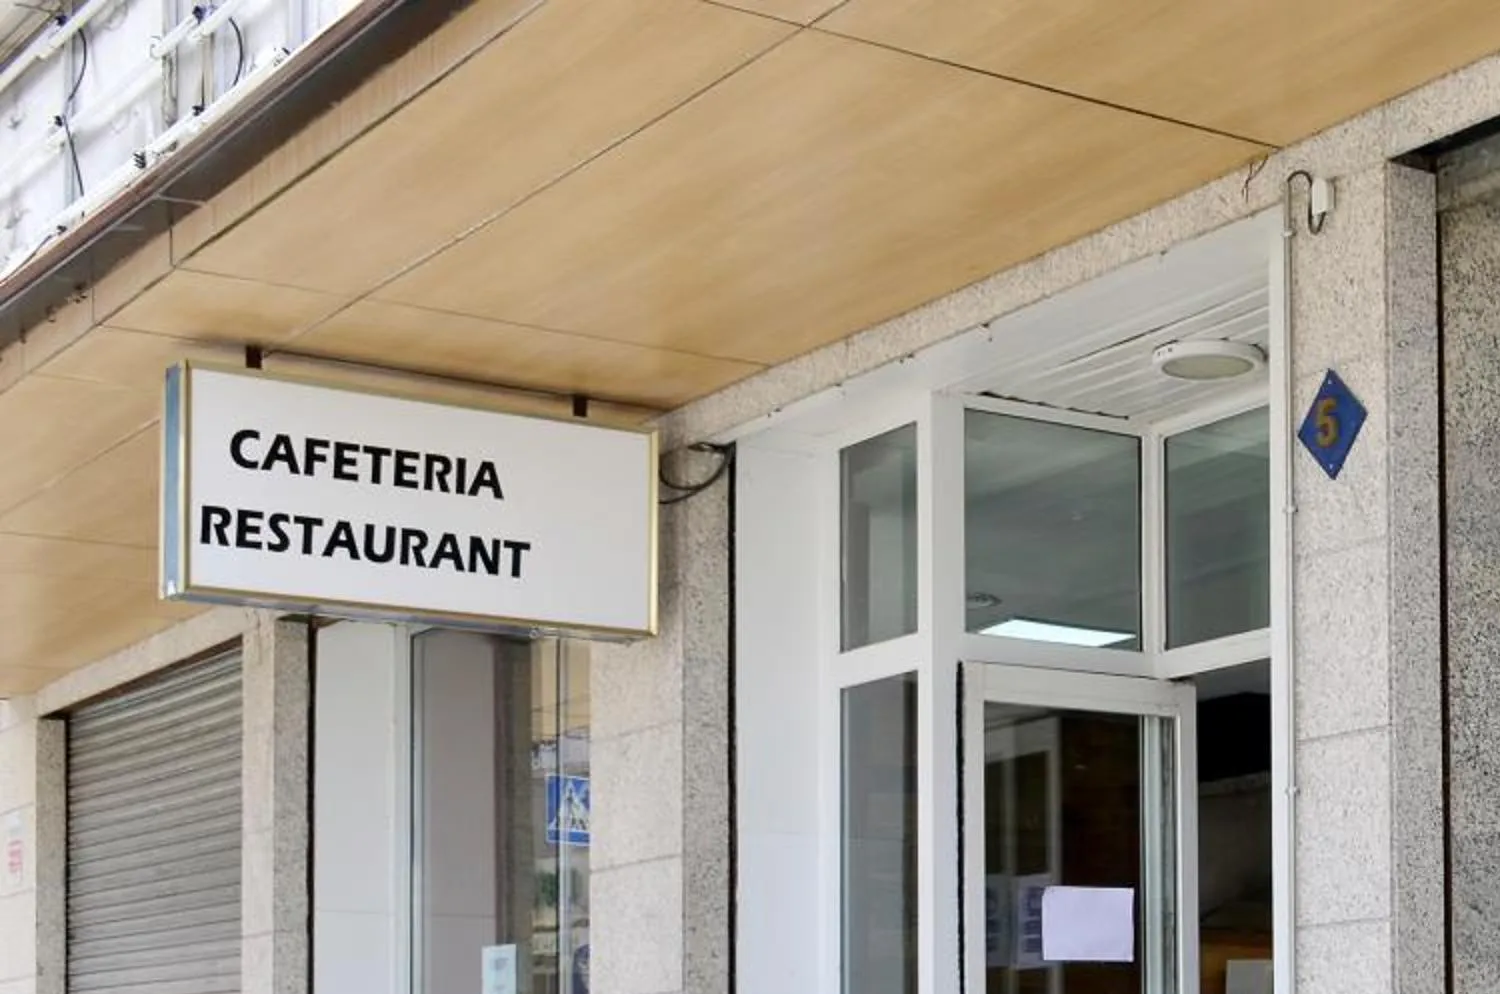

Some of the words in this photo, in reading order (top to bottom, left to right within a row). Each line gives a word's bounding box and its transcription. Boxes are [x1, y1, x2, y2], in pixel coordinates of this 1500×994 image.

[1315, 398, 1338, 449] 5
[229, 429, 504, 501] CAFETERIA
[199, 505, 531, 578] RESTAURANT
